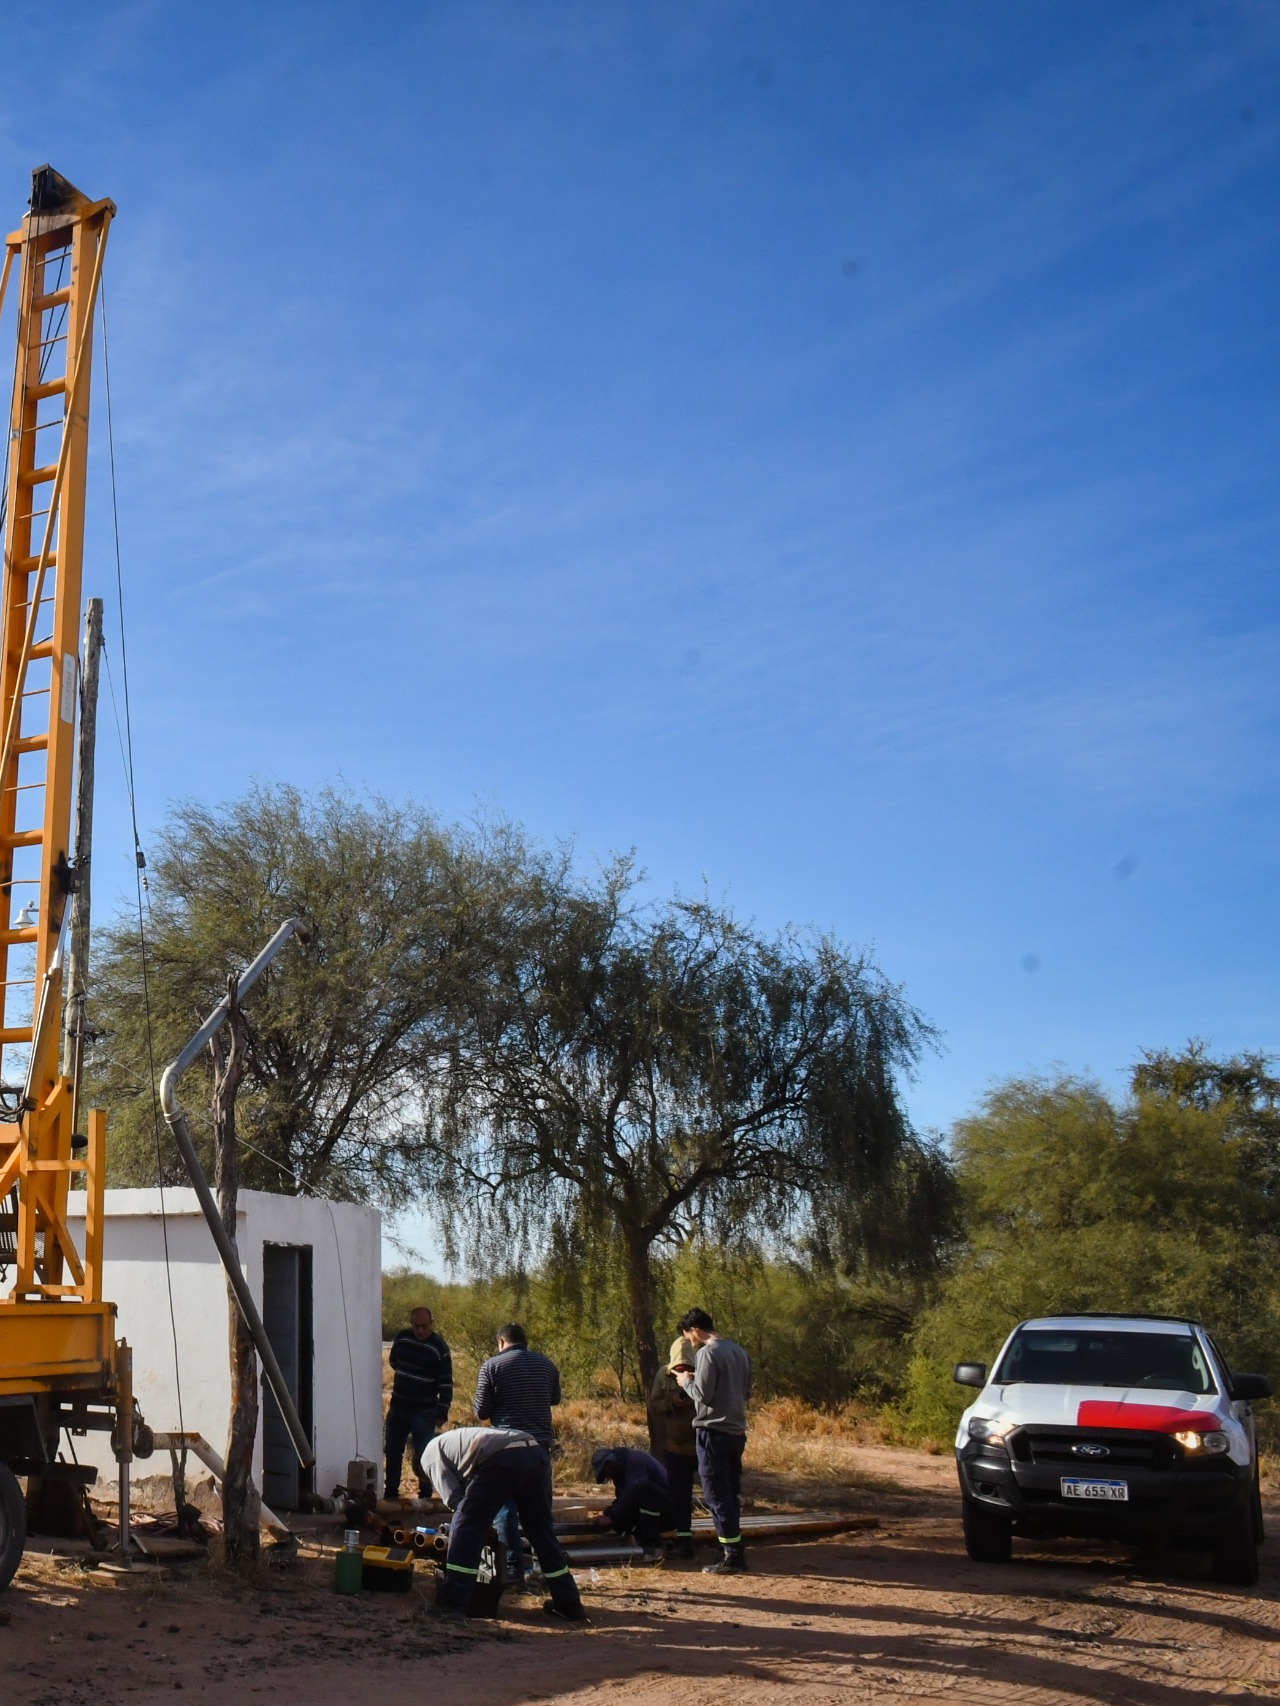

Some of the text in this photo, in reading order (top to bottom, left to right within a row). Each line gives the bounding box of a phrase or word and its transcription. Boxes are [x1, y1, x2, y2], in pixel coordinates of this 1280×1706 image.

[1066, 1484, 1126, 1499] AE 655 XR
